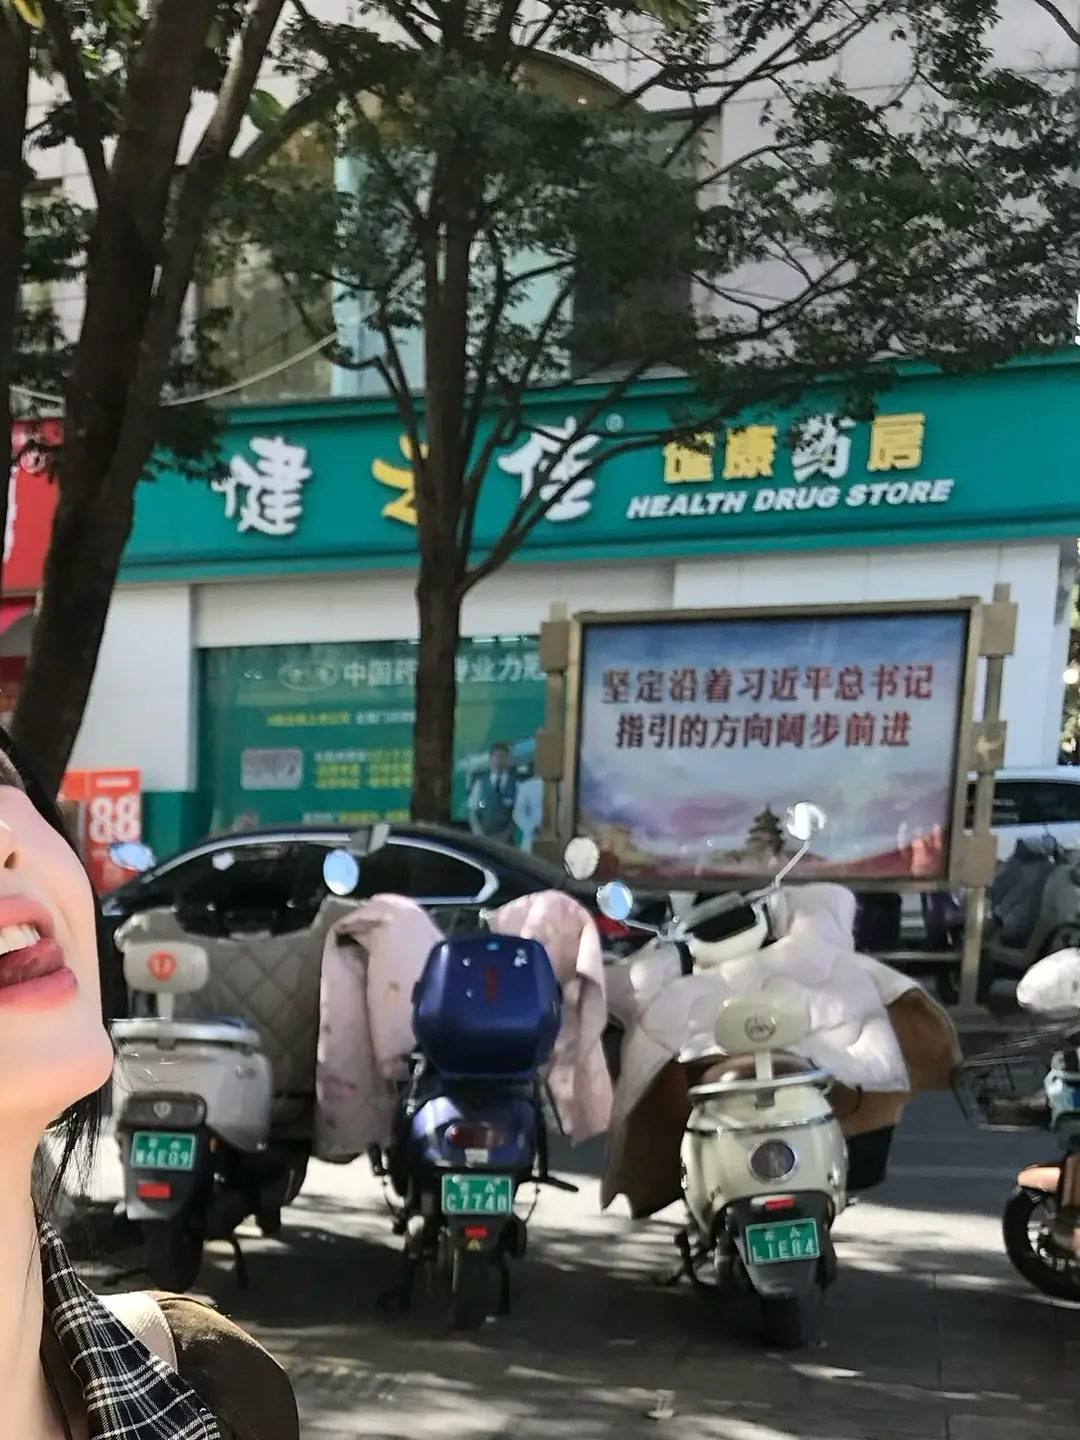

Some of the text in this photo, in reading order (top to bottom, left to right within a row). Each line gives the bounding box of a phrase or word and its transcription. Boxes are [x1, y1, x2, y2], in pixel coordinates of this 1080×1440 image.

[626, 478, 955, 519] HEALTH DRUG STORE
[602, 663, 934, 704] 坚定沿着习近平总书记
[615, 710, 911, 749] 指引的方向阔步前进
